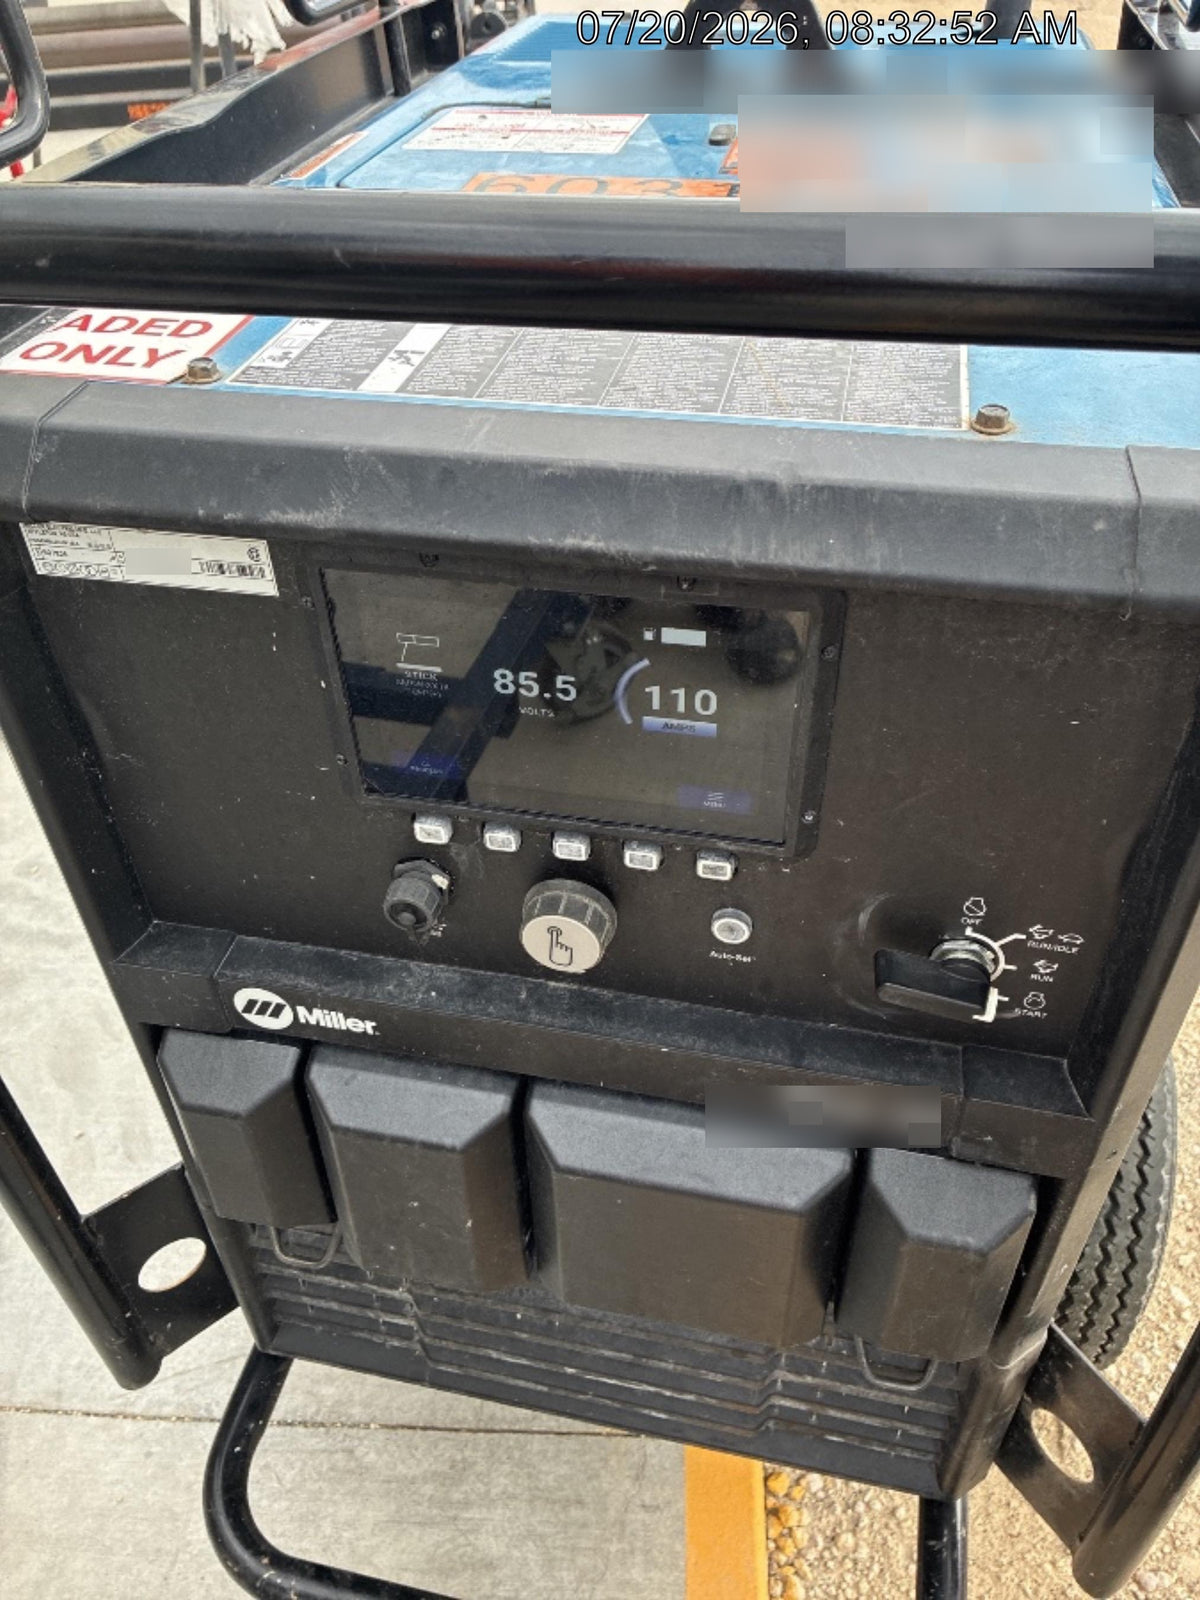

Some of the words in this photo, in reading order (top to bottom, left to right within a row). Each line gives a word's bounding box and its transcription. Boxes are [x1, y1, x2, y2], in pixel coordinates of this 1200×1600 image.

[20, 341, 187, 369] ONLY
[493, 668, 577, 702] 85.5
[644, 685, 718, 716] 110
[518, 706, 555, 718] VOLTS
[661, 721, 696, 733] AMPS
[960, 916, 982, 926] OFF
[1026, 940, 1080, 955] RUN/IDLE
[1030, 973, 1054, 983] RUN
[1014, 1007, 1048, 1019] START
[296, 1005, 379, 1036] Miller
